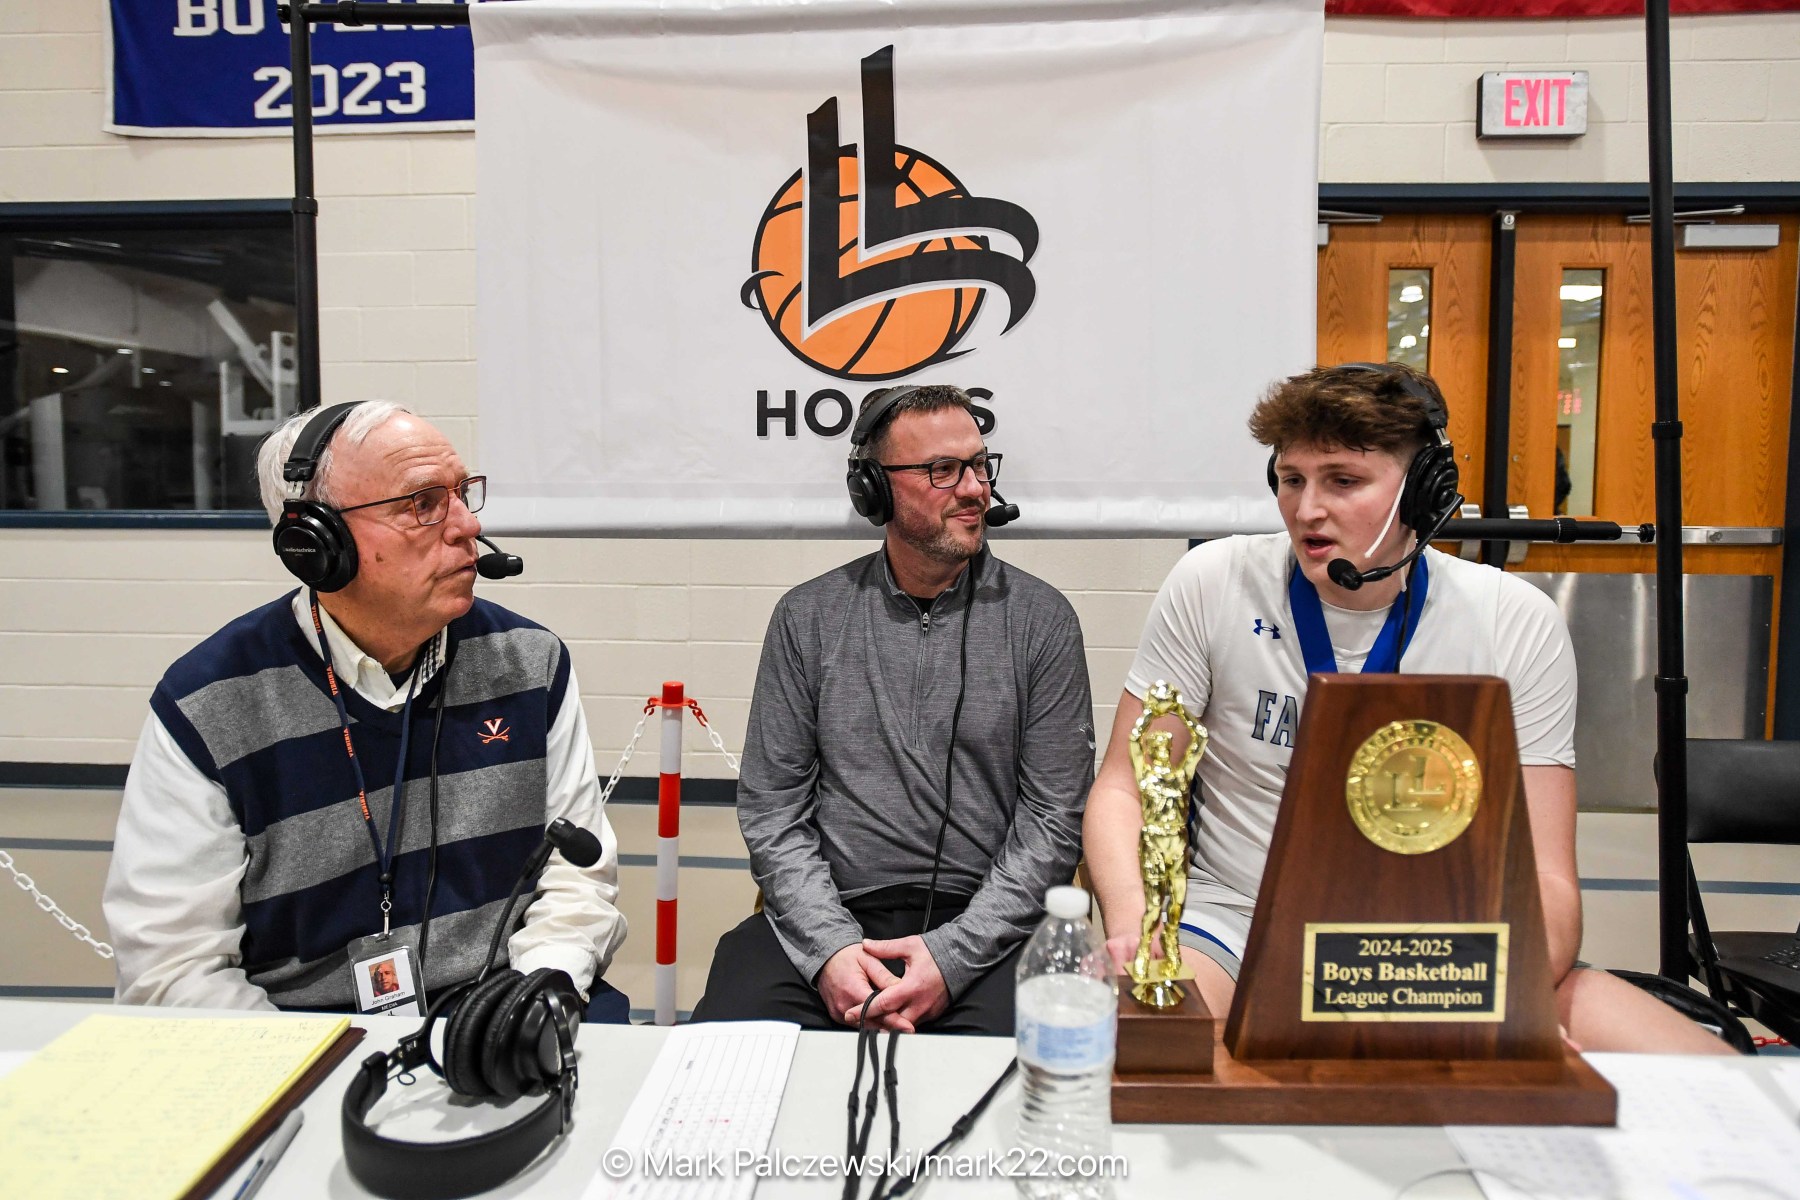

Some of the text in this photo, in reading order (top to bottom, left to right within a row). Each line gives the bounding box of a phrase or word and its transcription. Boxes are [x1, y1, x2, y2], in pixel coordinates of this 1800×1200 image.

[253, 62, 426, 119] 2023
[1505, 79, 1572, 126] EXIT
[757, 387, 996, 437] HOS
[1358, 939, 1453, 957] 2024-2025
[1322, 962, 1487, 985] Boys Basketball
[371, 998, 384, 1006] John
[1325, 988, 1483, 1009] League Champion
